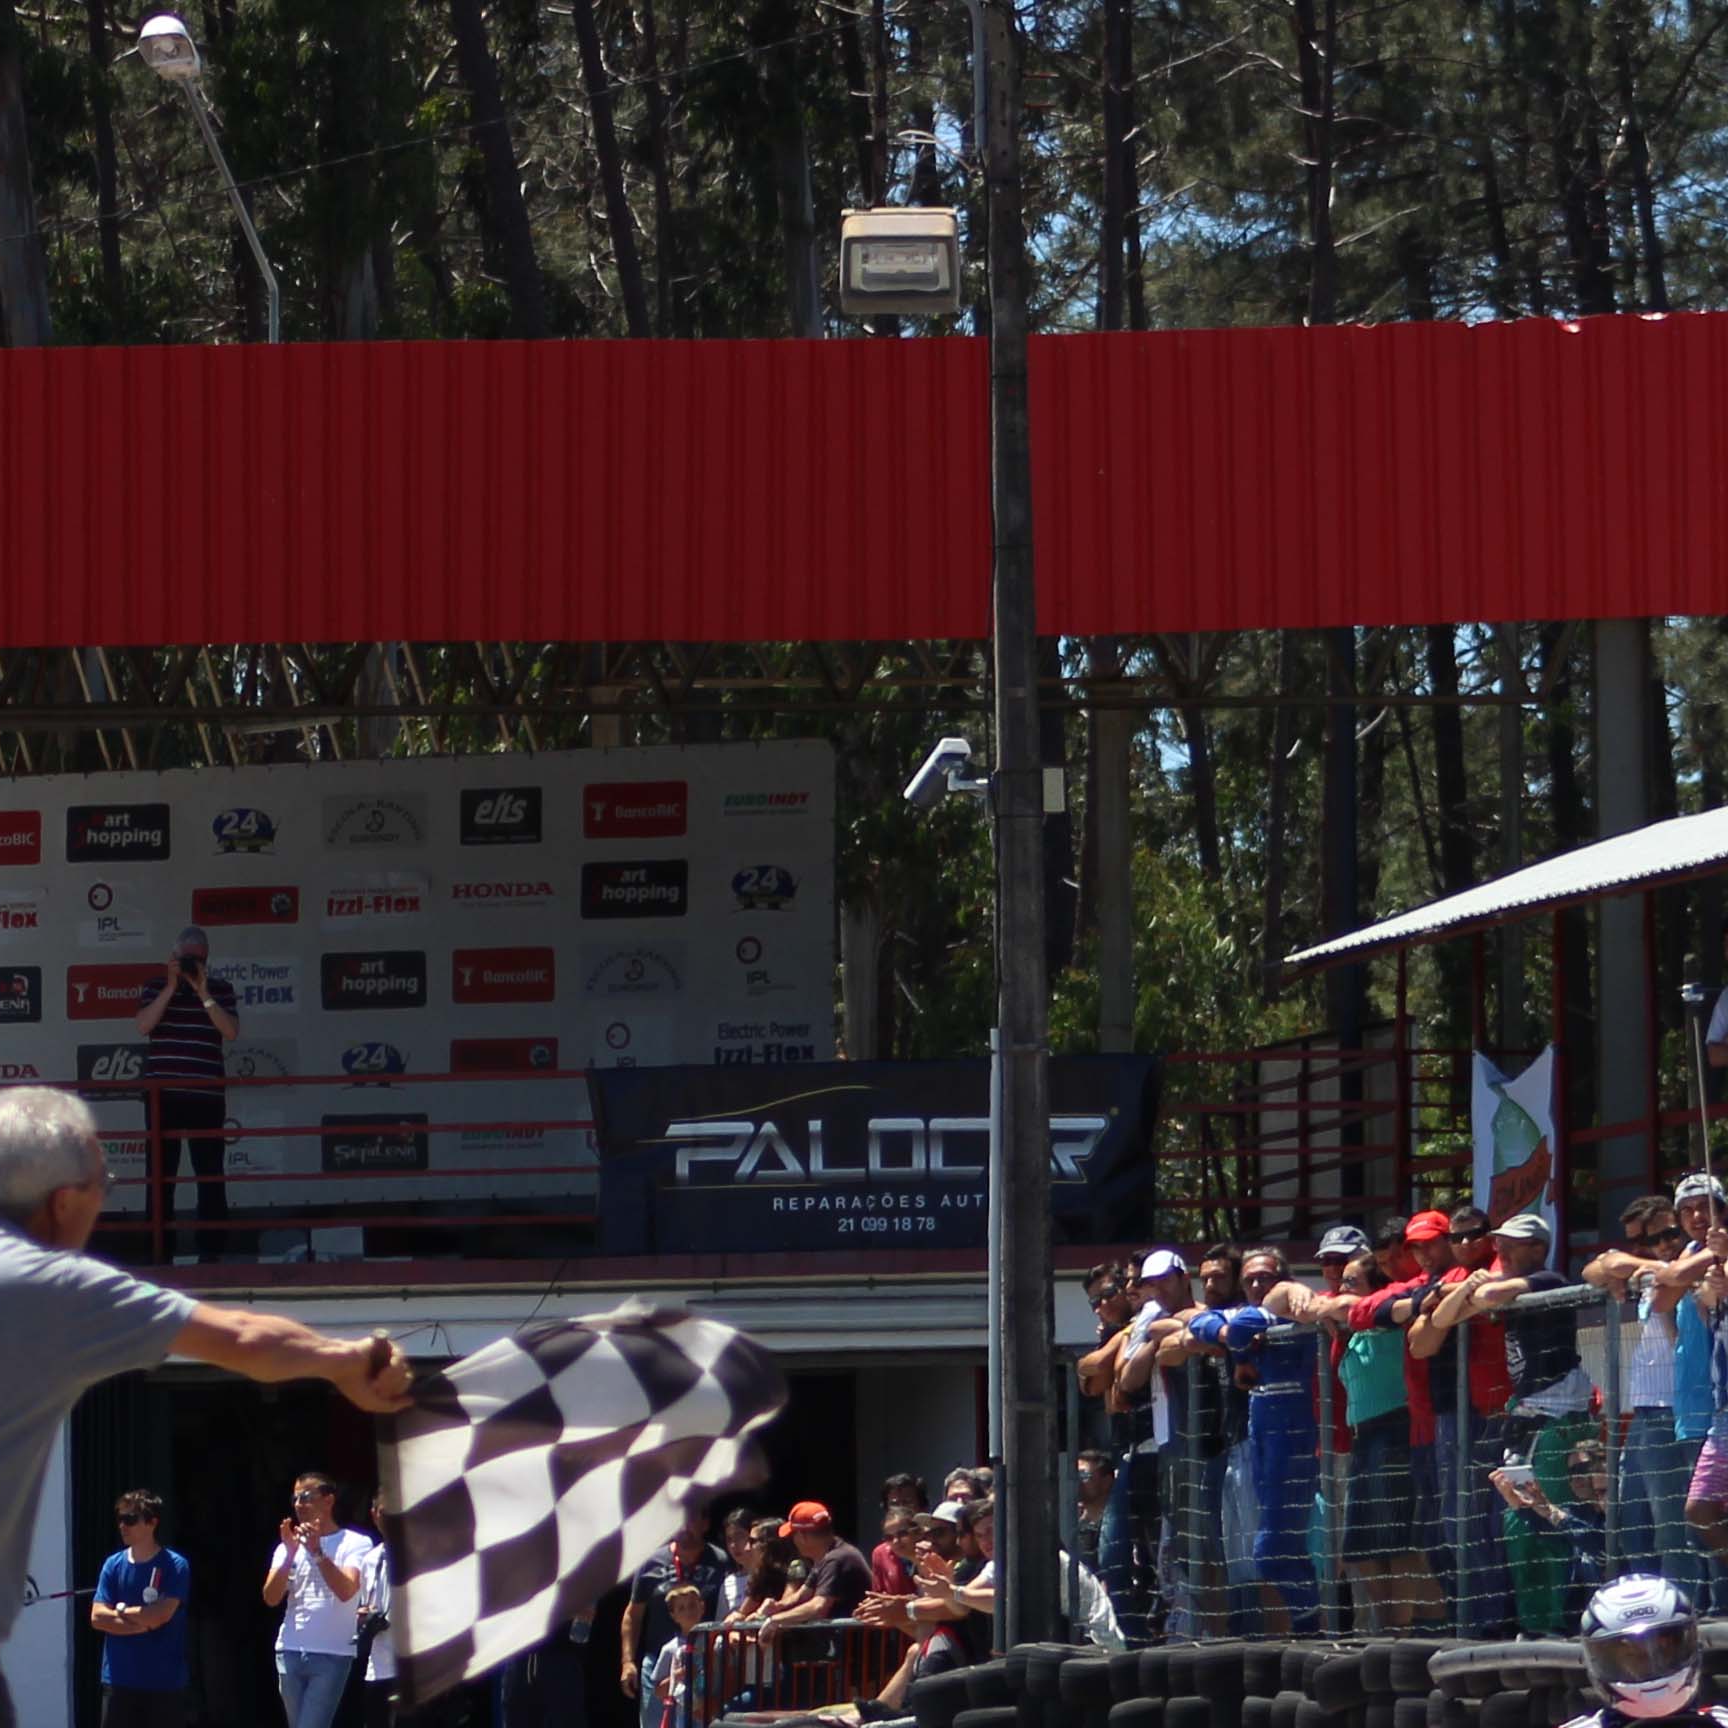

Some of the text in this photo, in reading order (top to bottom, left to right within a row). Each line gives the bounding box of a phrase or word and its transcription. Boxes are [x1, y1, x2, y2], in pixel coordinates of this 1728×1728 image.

[222, 811, 259, 836] 24
[451, 881, 555, 899] HONDA
[742, 868, 779, 893] 24
[352, 1046, 390, 1070] 24
[665, 1117, 1108, 1185] PALOCR
[772, 1191, 986, 1212] REPARAÇÕES AUT
[837, 1217, 855, 1233] 21
[893, 1216, 913, 1232] 18
[916, 1216, 936, 1232] 78
